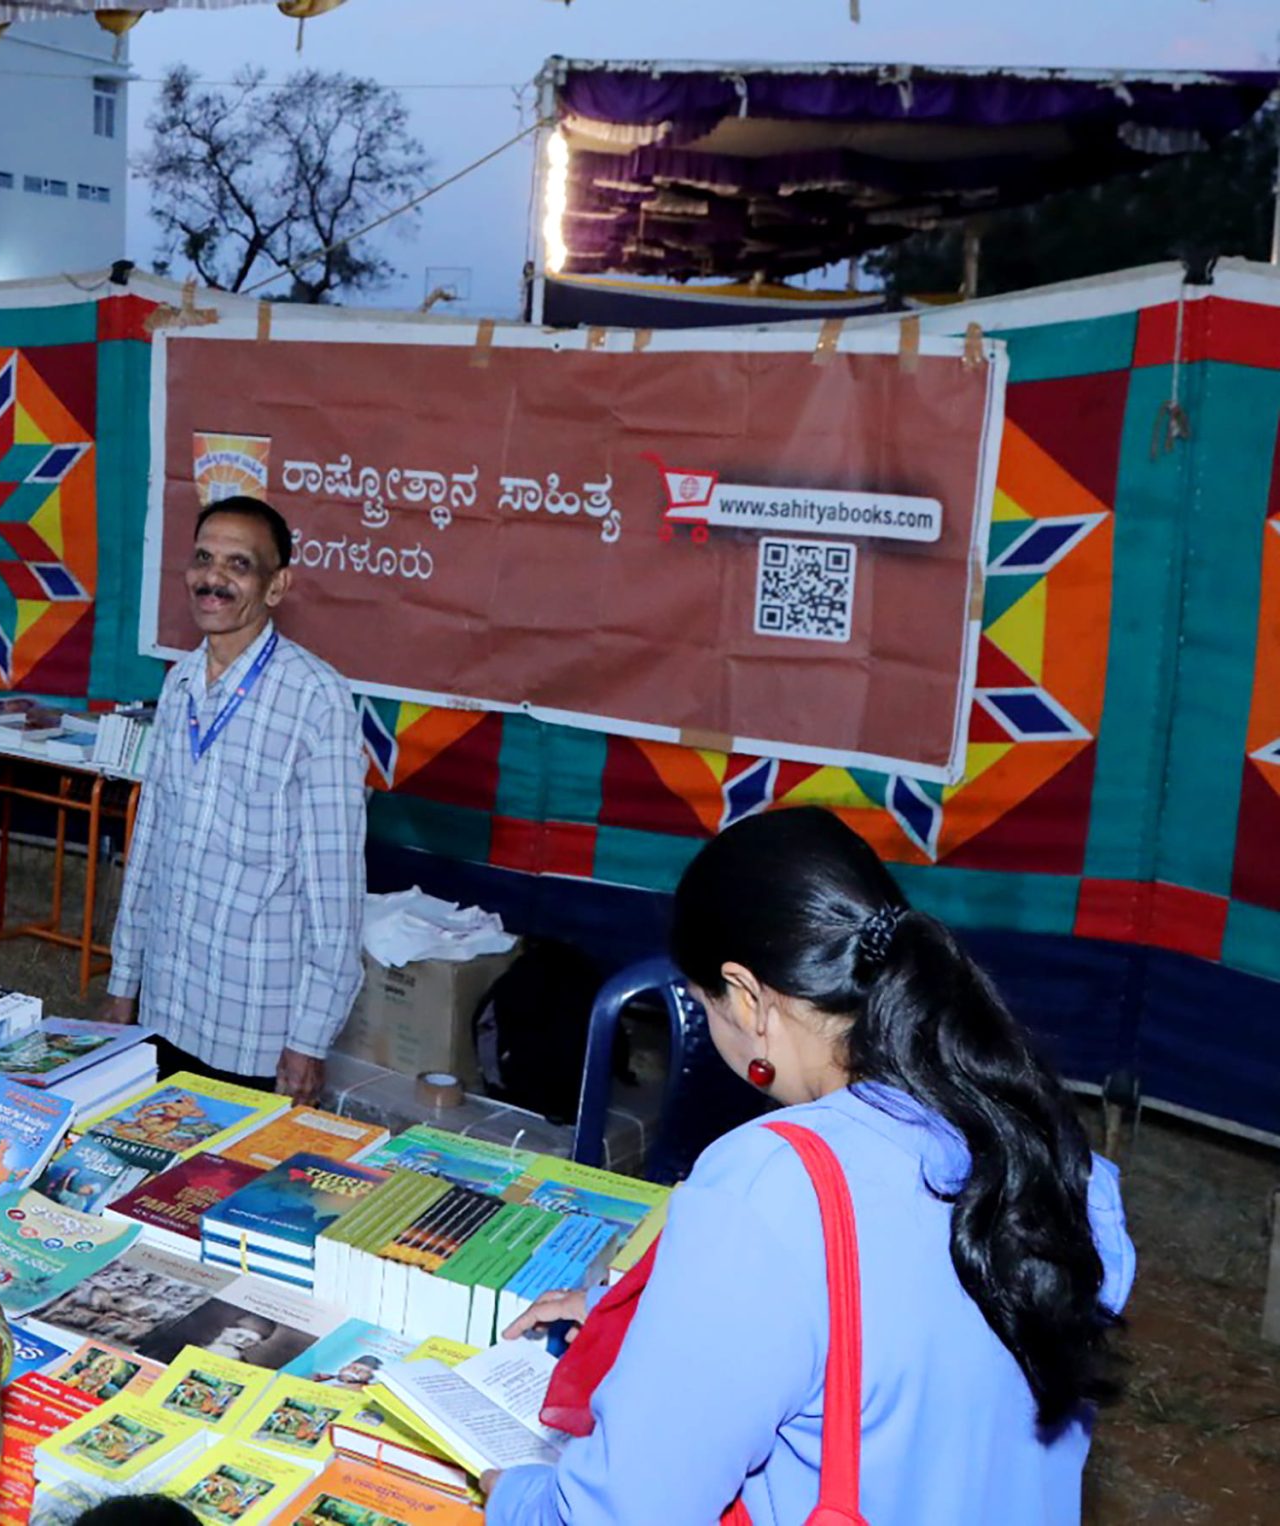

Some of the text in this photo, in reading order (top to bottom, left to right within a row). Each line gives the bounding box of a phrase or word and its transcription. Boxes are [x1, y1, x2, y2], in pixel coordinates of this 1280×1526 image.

[282, 454, 622, 543] ರಾಷ್ಟ್ರೋತ್ಥಾನ ಸಾಹಿತ್ಯ
[719, 497, 934, 530] www.sahityabooks.com
[132, 1194, 200, 1226] PARTITIO
